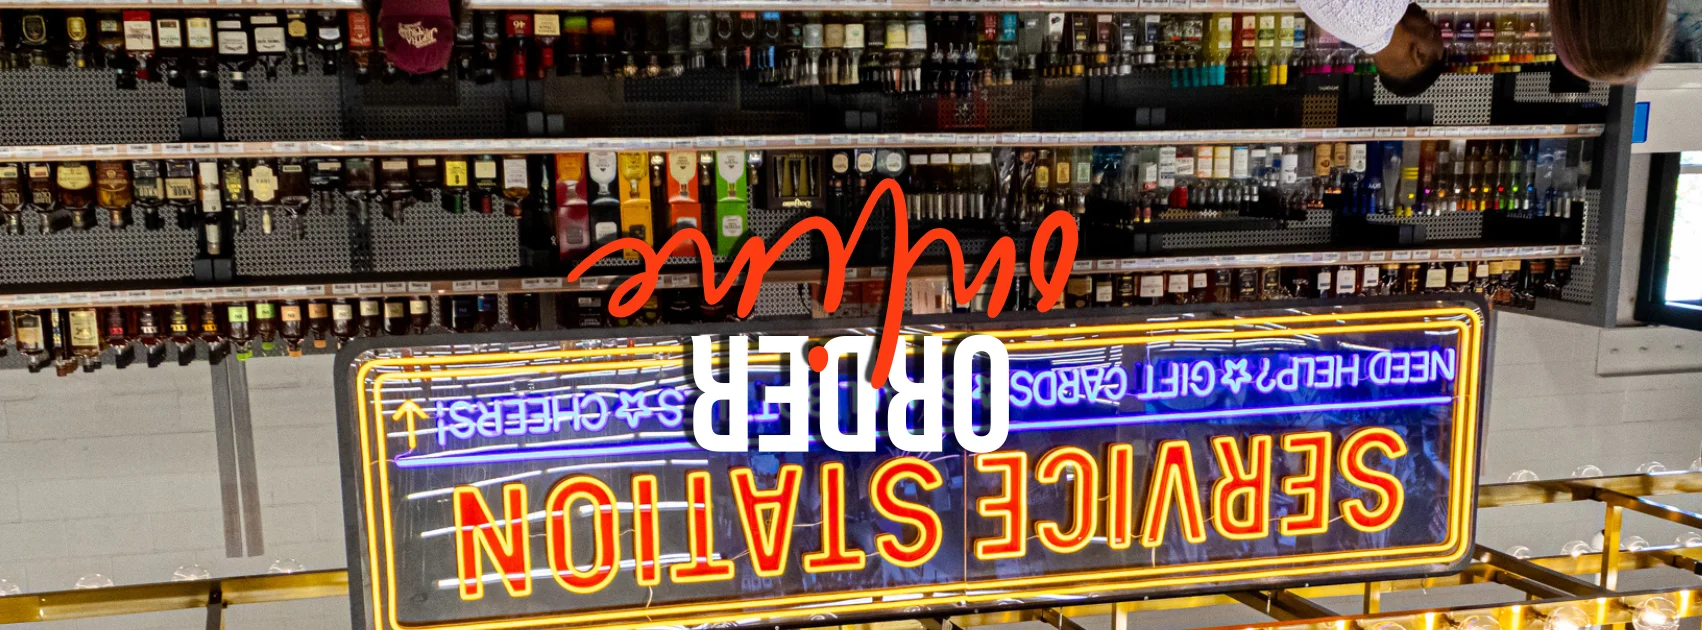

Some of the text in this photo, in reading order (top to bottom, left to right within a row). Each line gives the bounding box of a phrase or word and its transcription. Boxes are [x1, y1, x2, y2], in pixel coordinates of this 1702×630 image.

[513, 20, 525, 28] 46
[1136, 361, 1215, 399] GIFT
[1256, 354, 1360, 392] HELP?
[1368, 348, 1455, 386] NEED
[1008, 366, 1128, 407] CARDS
[435, 393, 608, 447] CHEERS!
[453, 427, 1408, 600] SERVICE STATION
